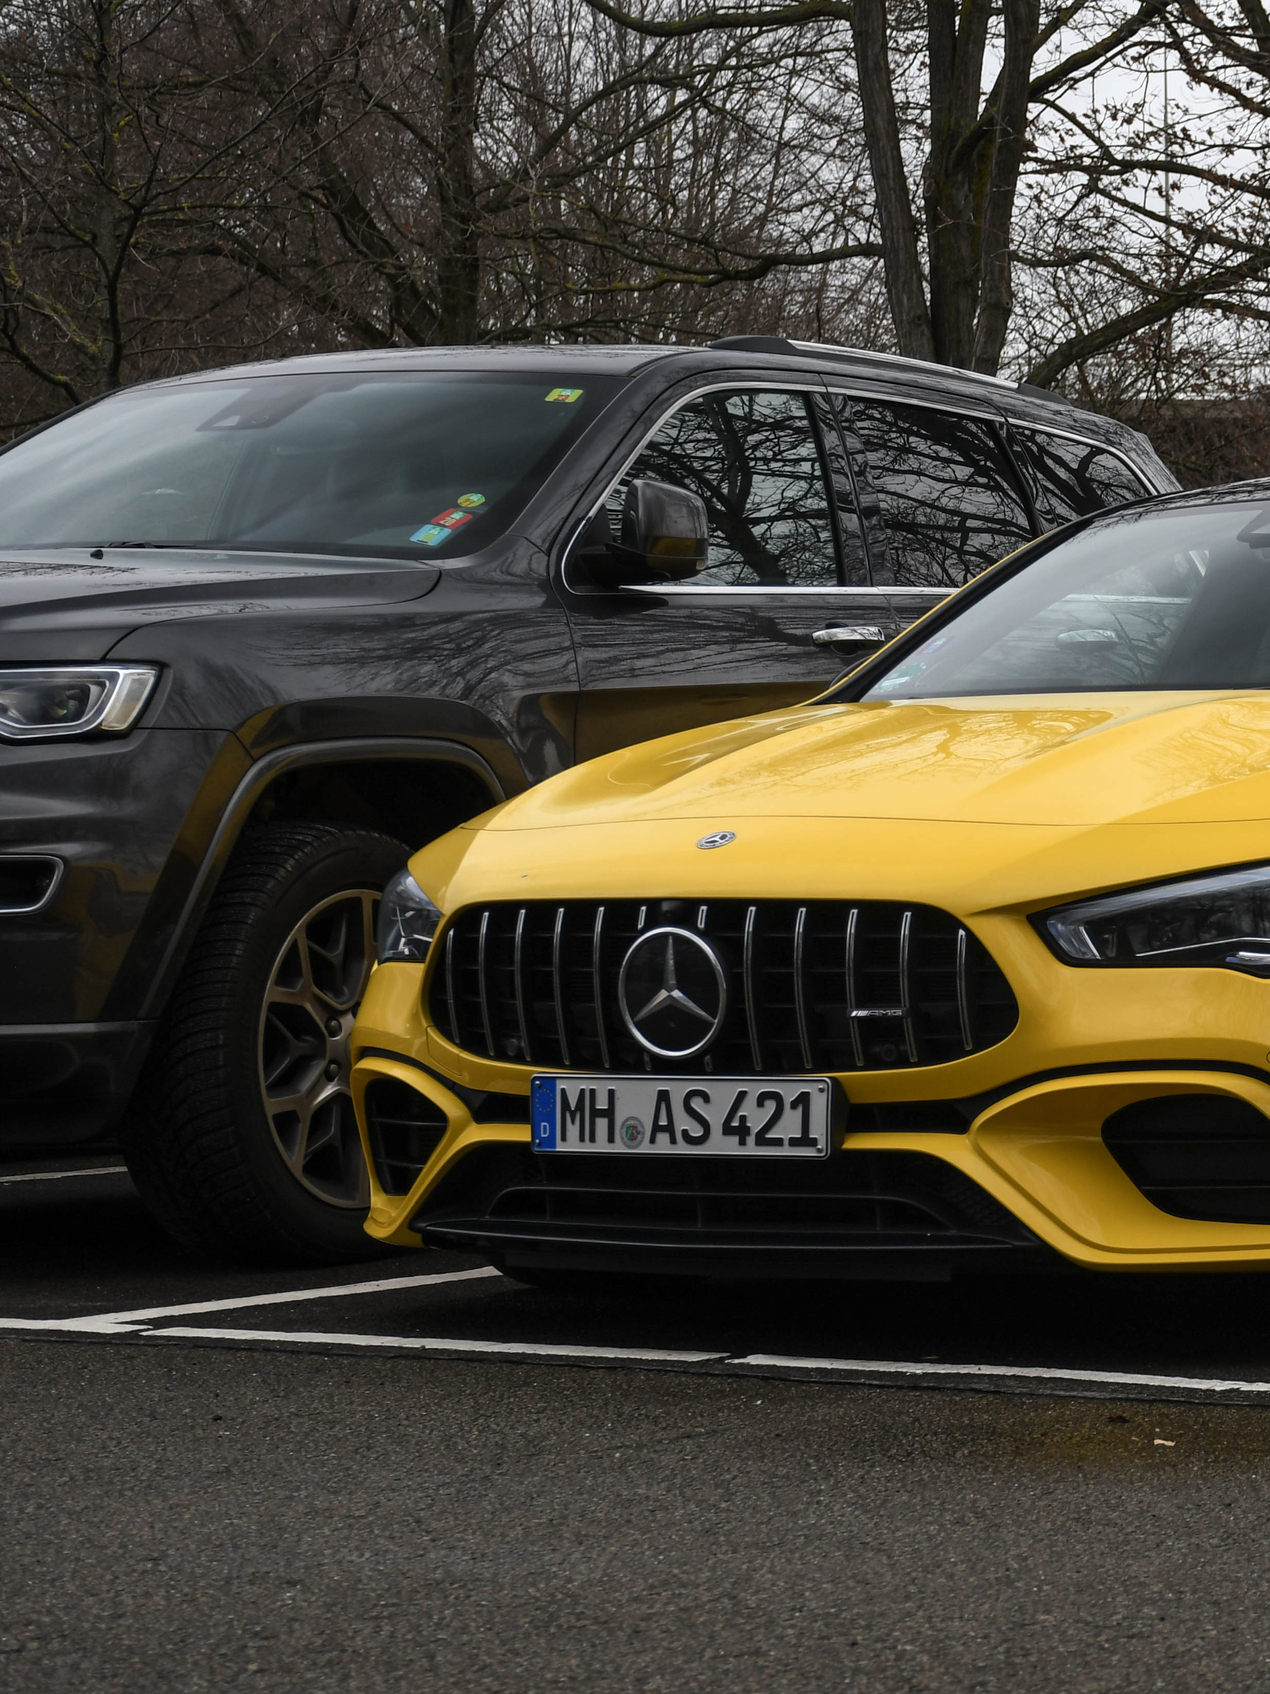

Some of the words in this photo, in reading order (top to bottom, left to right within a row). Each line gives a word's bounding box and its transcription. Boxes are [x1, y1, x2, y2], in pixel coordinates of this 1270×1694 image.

[540, 1122, 549, 1138] D
[560, 1086, 616, 1144] MH
[648, 1087, 712, 1146] AS
[721, 1089, 819, 1147] 421
